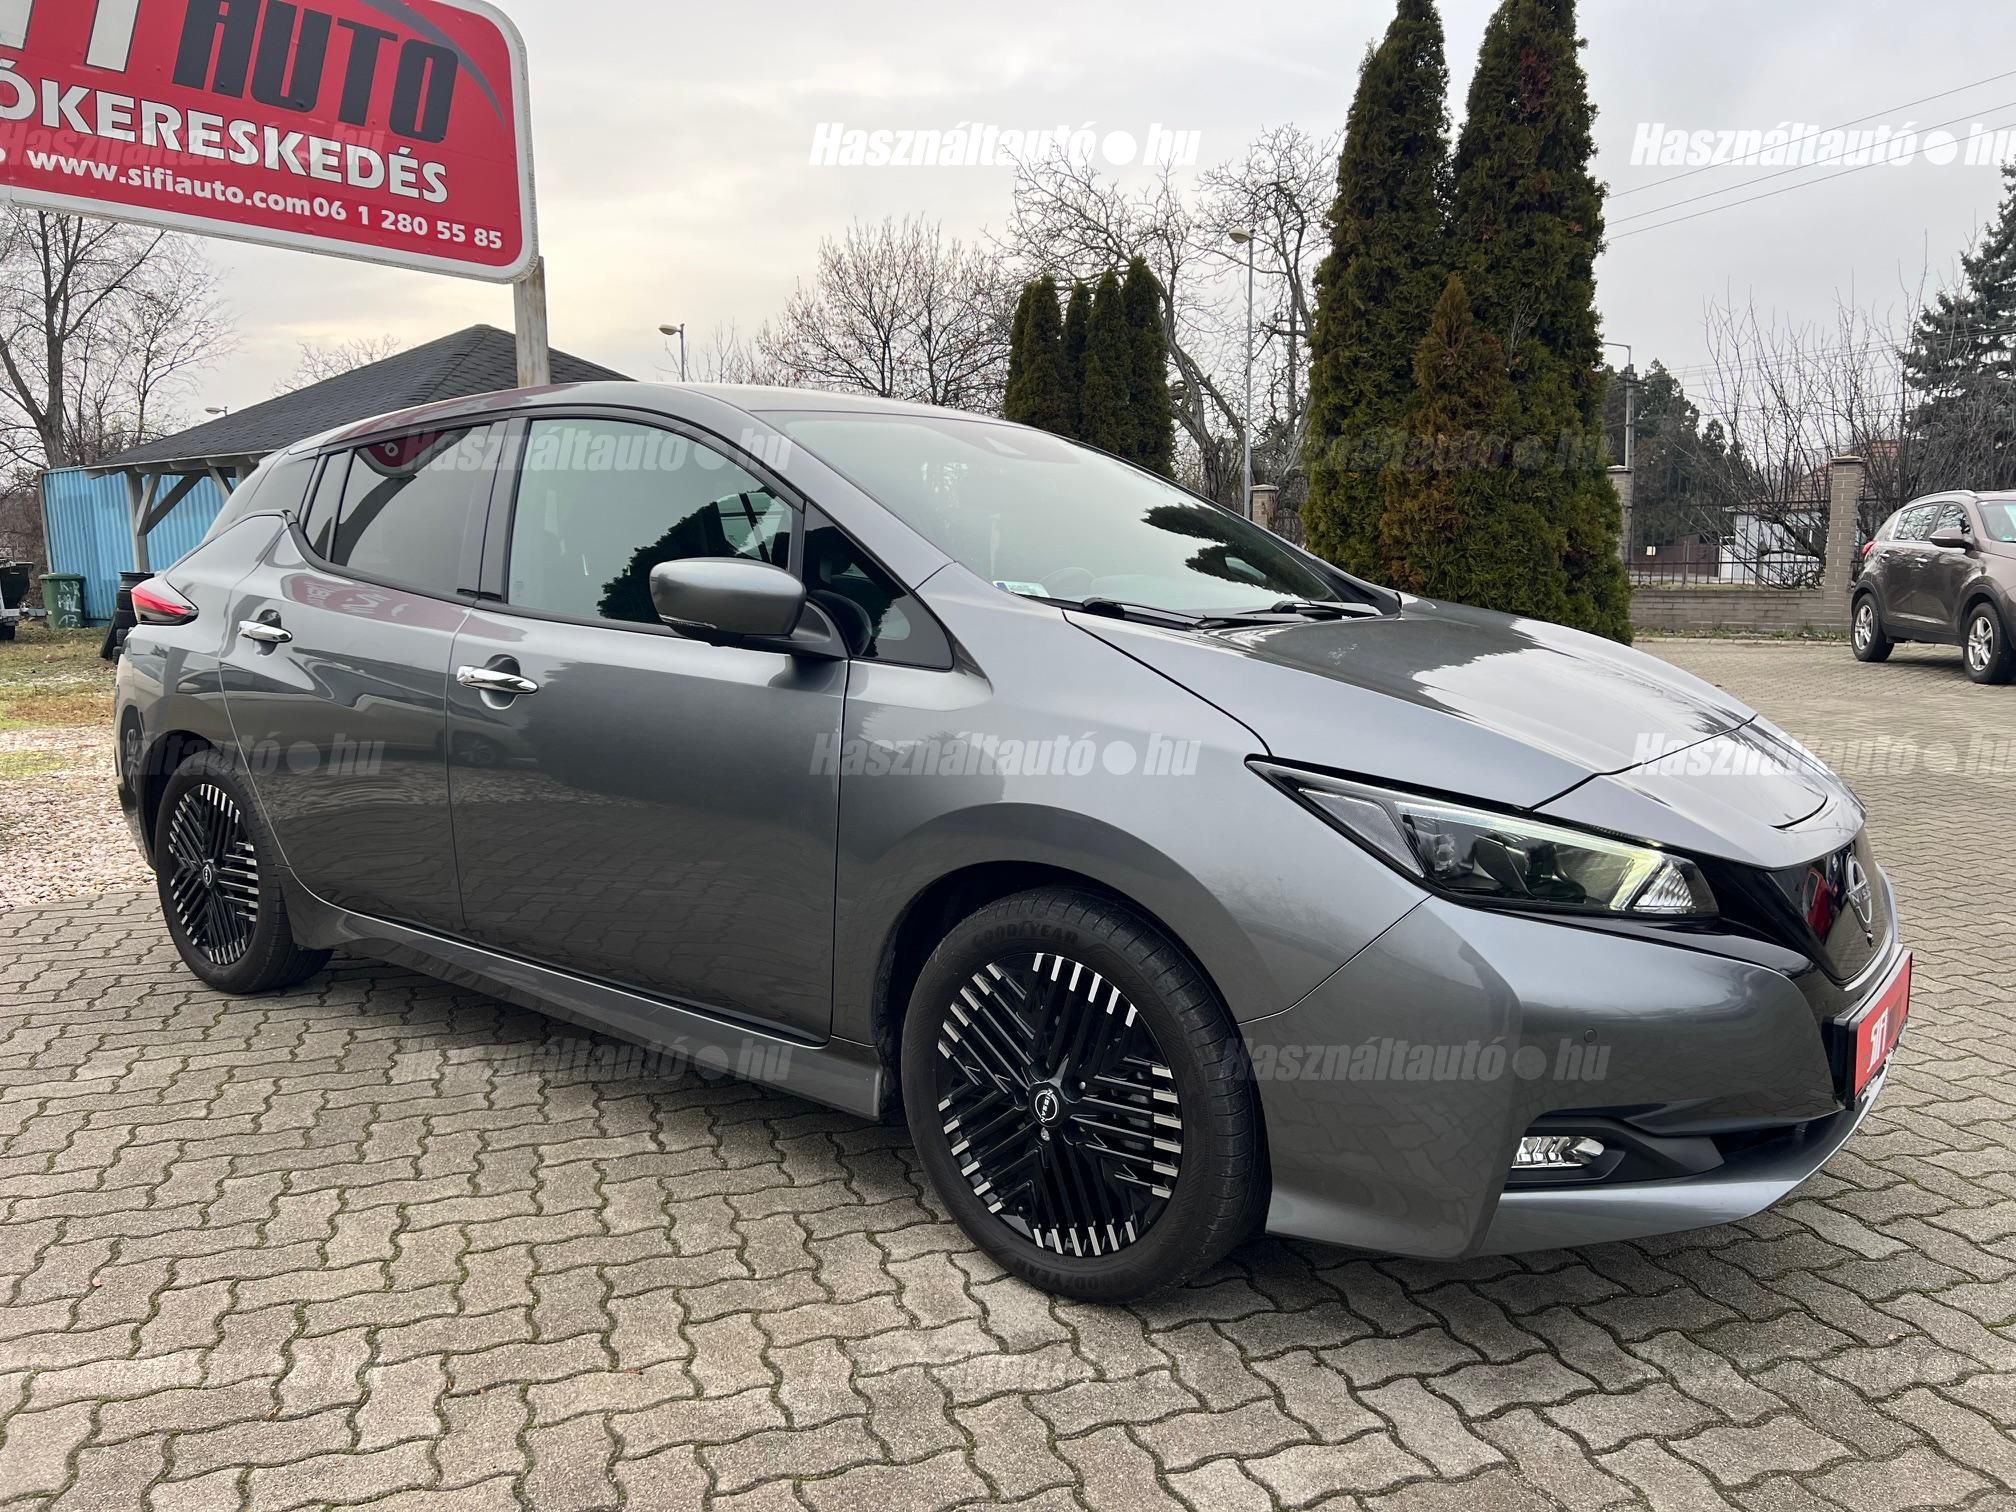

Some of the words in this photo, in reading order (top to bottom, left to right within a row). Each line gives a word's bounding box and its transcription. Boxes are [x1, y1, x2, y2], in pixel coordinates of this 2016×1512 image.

[313, 196, 347, 221] 06
[358, 205, 369, 225] 1
[381, 209, 428, 236] 280
[437, 220, 466, 243] 55
[474, 227, 502, 249] 85
